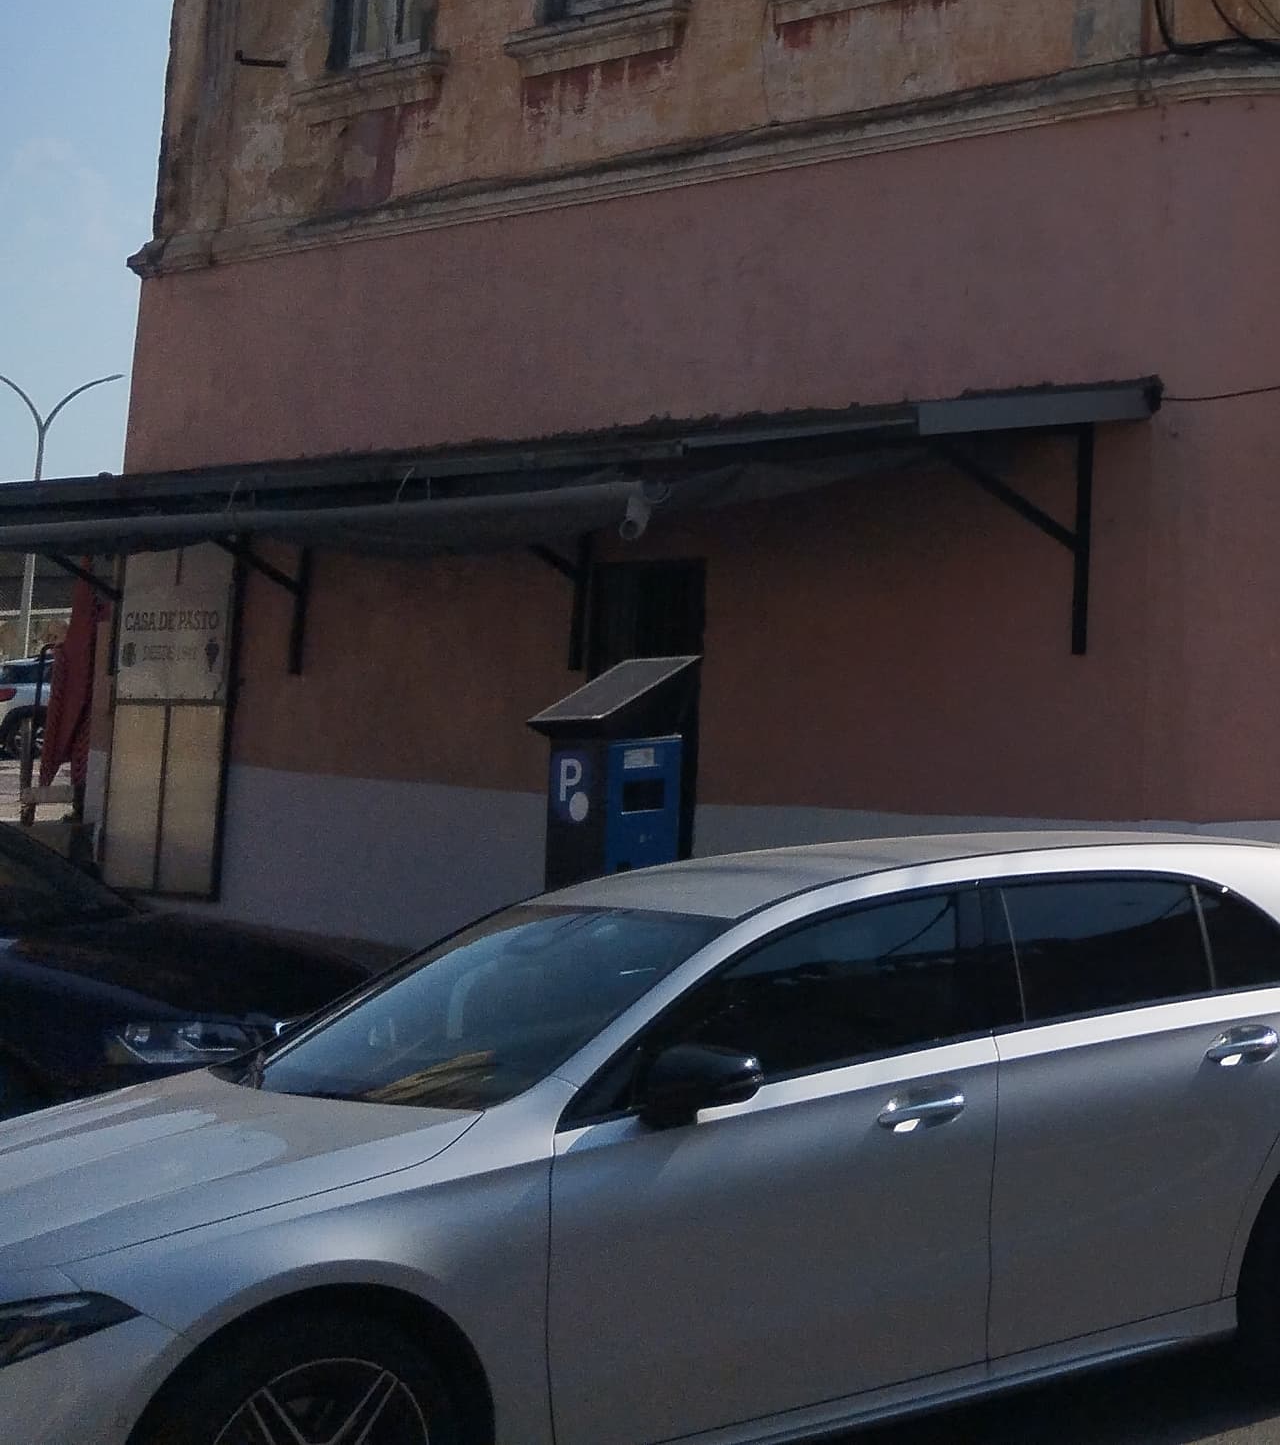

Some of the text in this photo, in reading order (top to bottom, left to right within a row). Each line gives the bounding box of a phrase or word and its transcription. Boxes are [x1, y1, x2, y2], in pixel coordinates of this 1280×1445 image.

[125, 610, 219, 631] CASA DE PASTO
[560, 758, 583, 802] P
